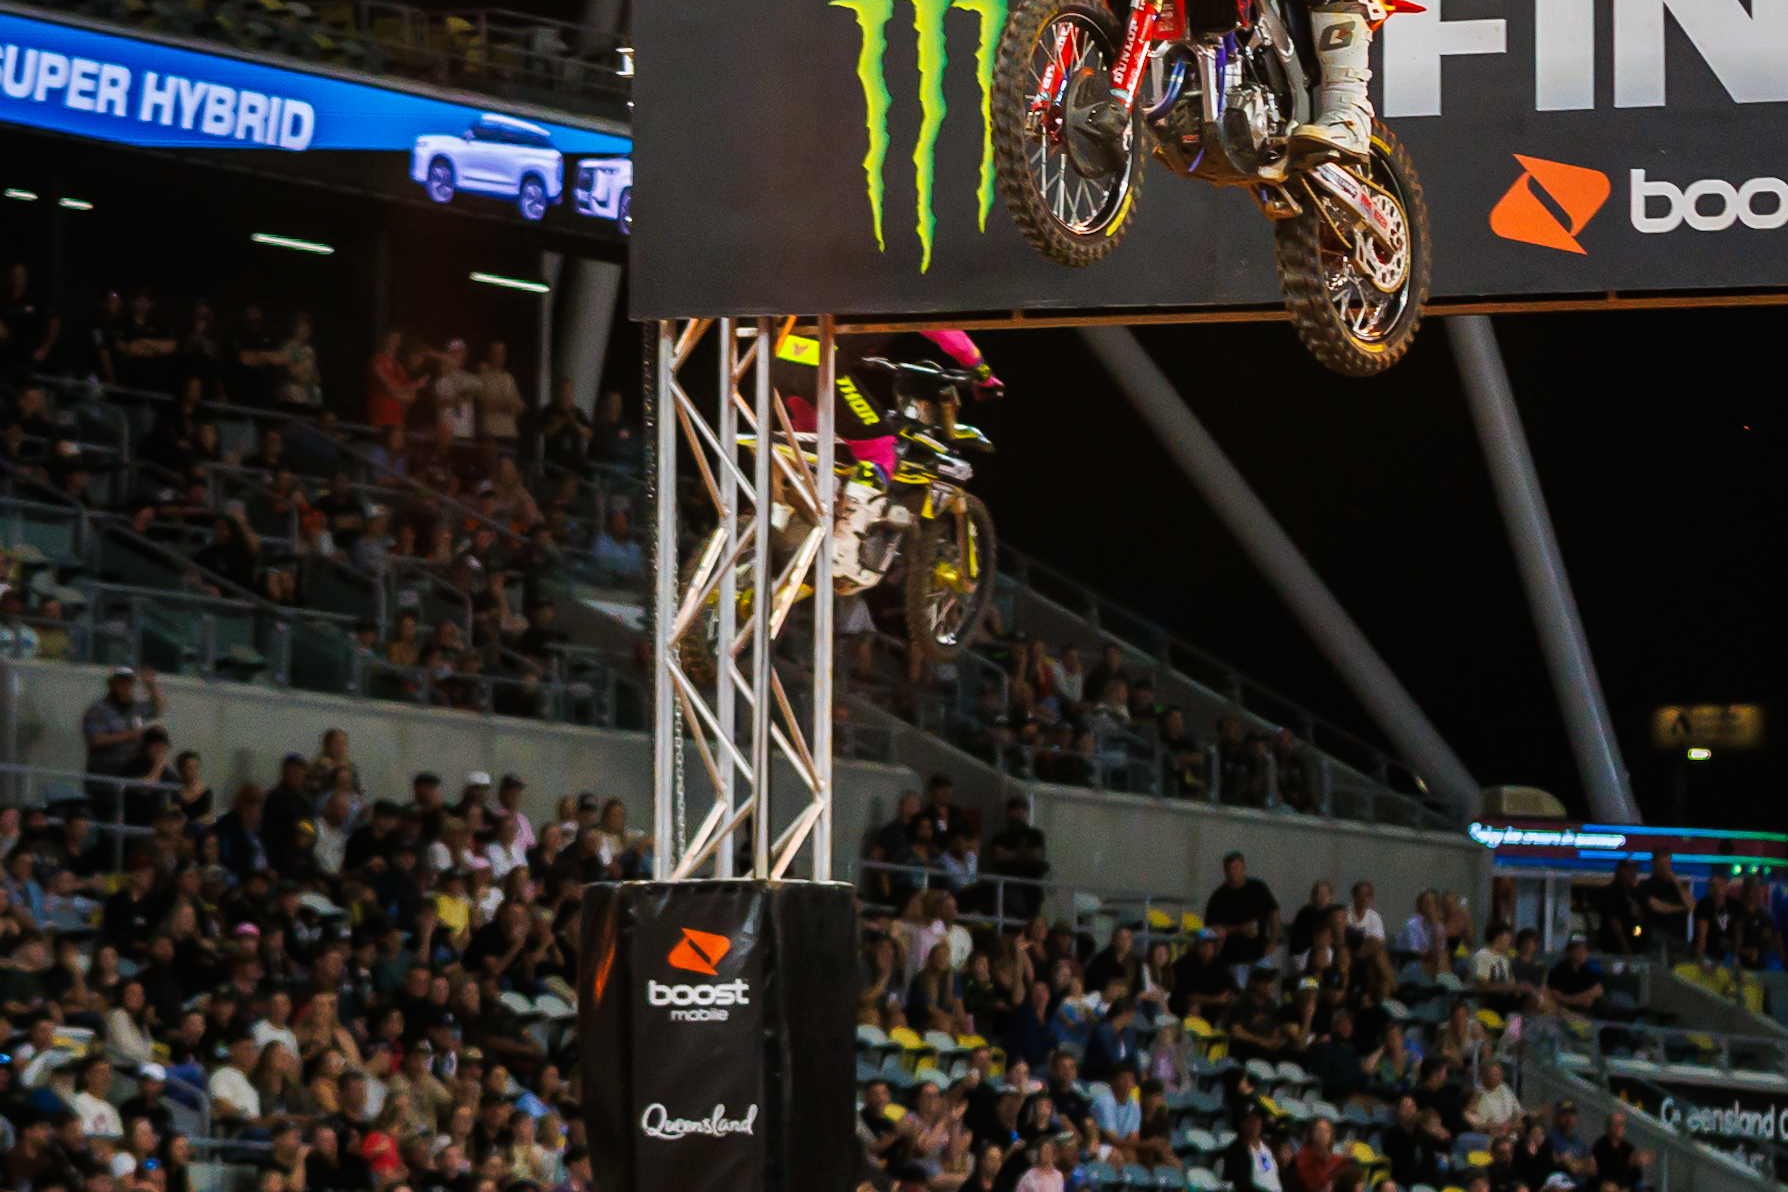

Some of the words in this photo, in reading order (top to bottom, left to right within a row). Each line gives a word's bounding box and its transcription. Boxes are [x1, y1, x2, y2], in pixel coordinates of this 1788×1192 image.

[0, 44, 131, 118] UPER
[139, 71, 315, 152] HYBRID
[835, 374, 881, 427] THOR
[648, 978, 750, 1006] boost
[670, 1007, 730, 1022] mobile
[640, 1103, 758, 1140] Queensland
